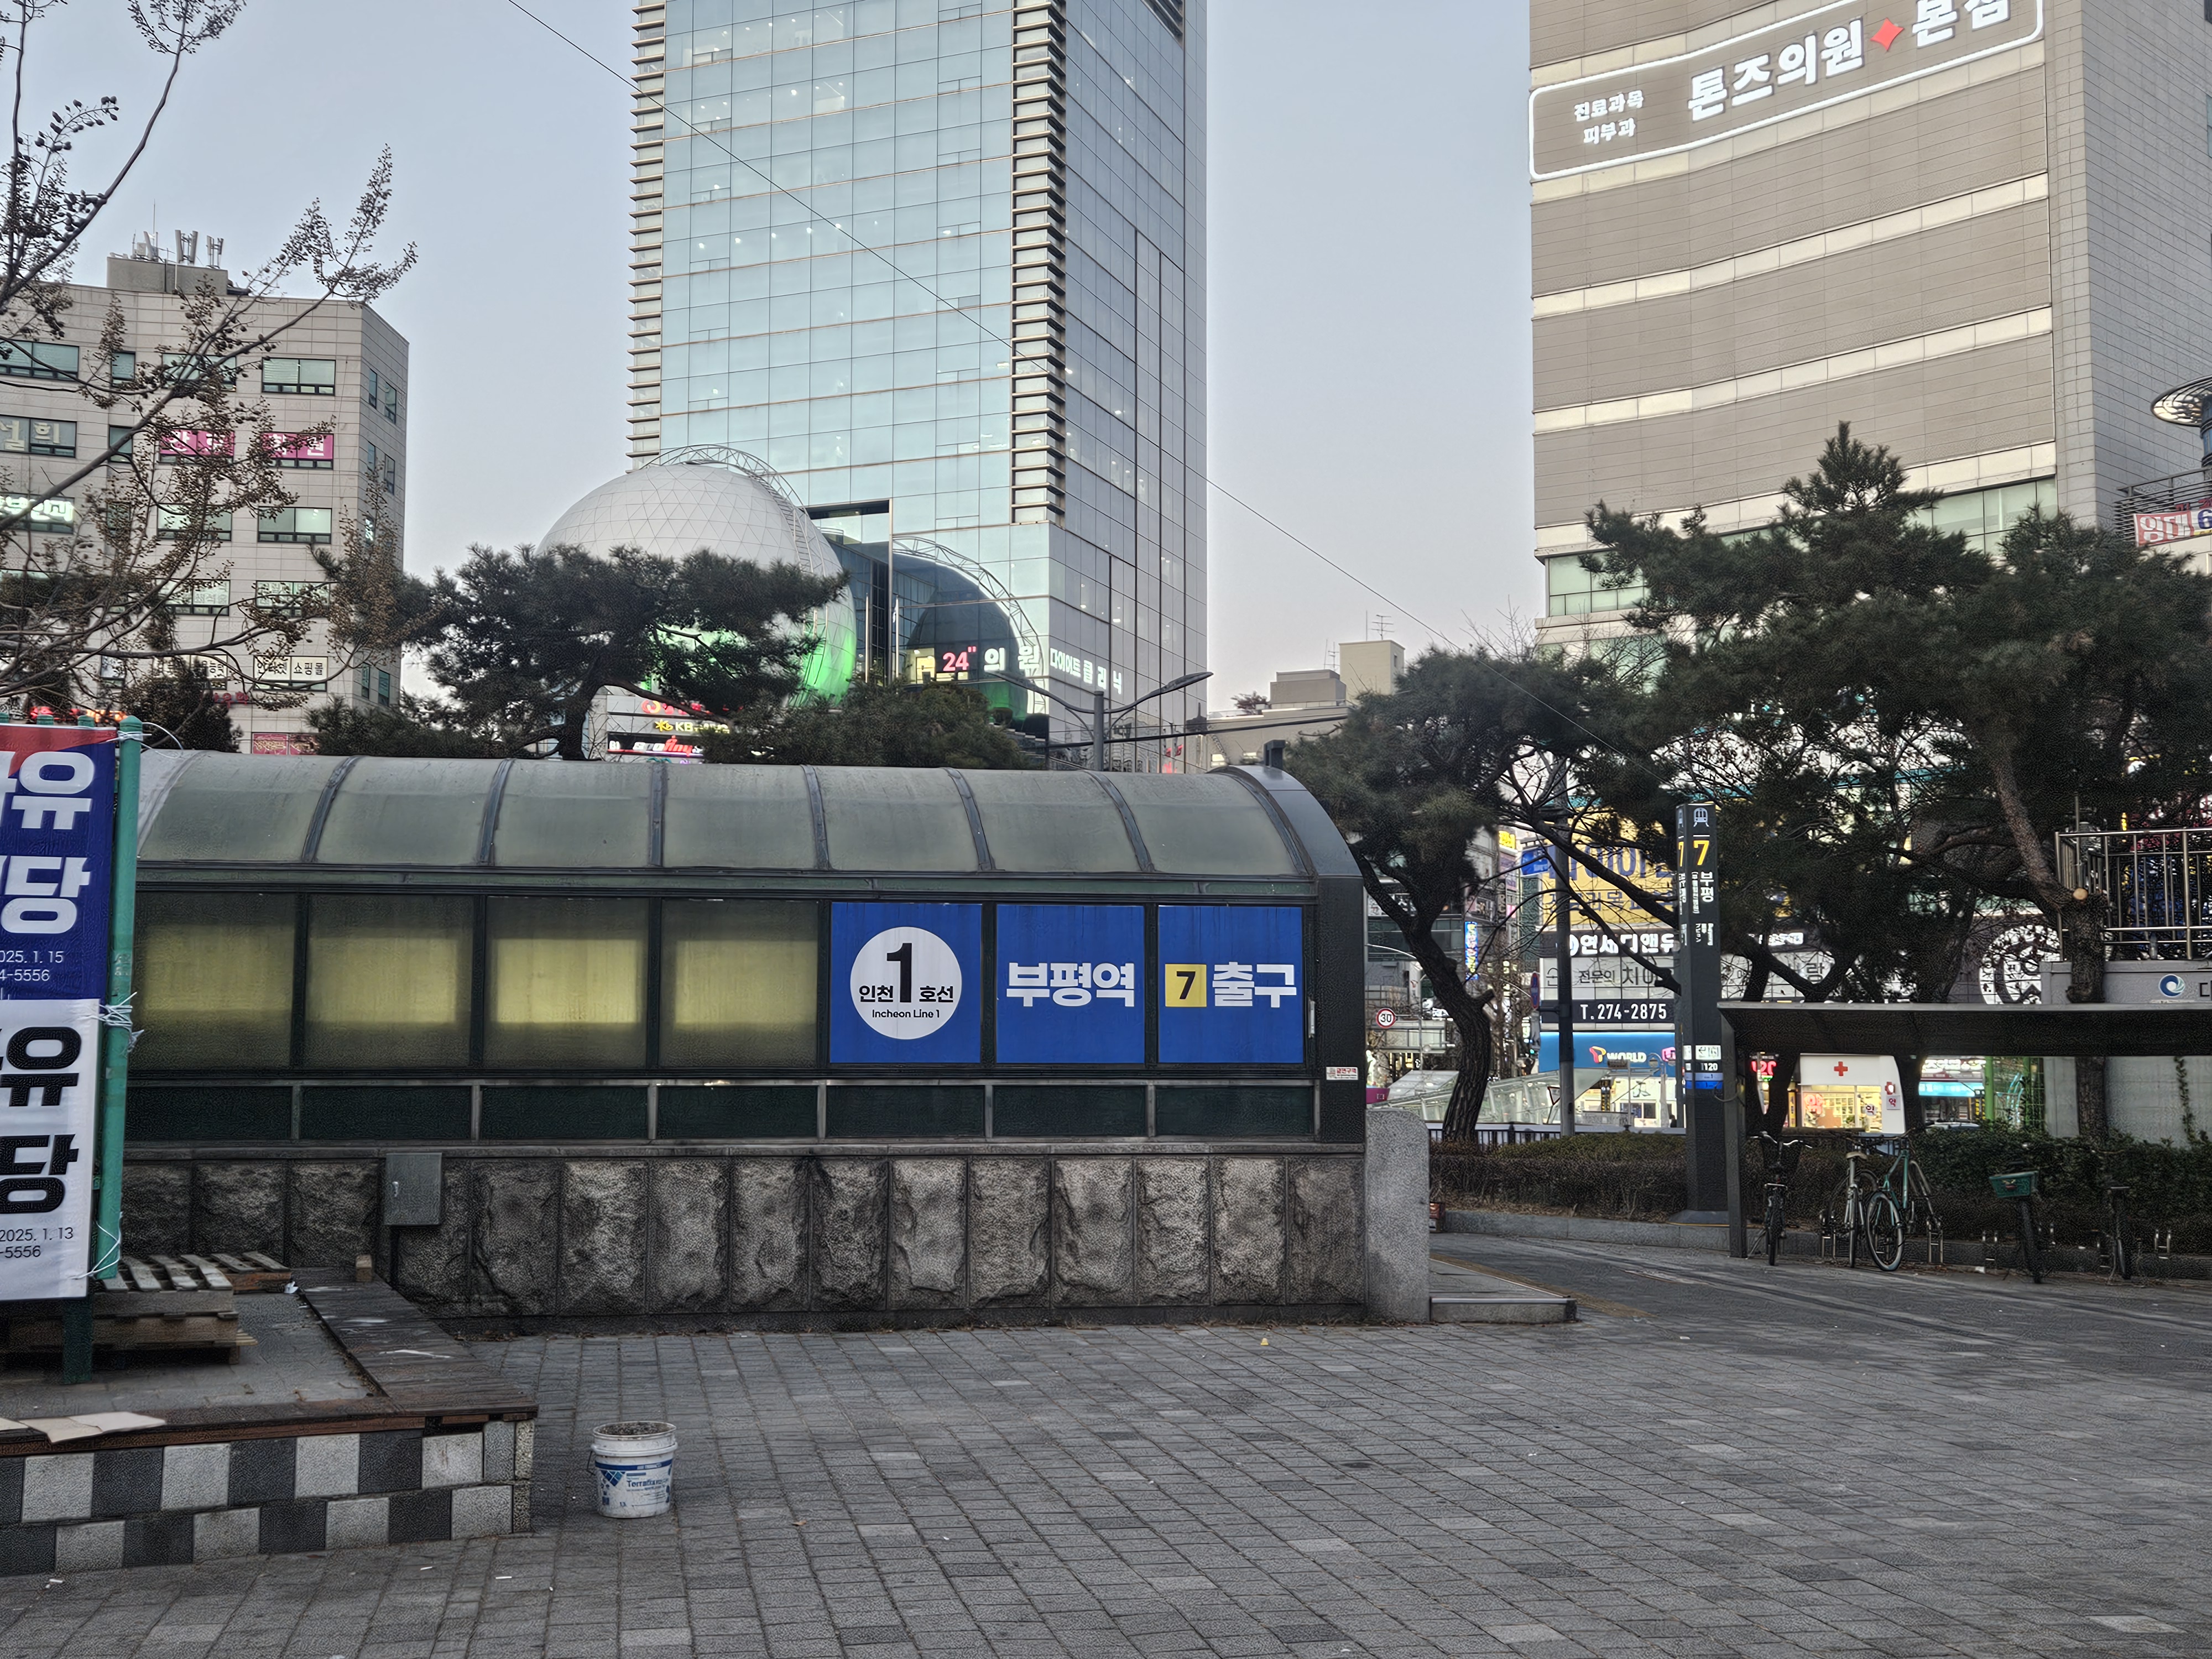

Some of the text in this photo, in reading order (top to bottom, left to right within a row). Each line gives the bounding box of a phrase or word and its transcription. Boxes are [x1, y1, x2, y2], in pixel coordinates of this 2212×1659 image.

[1687, 19, 1865, 121] 톤즈의원
[1574, 90, 1644, 122] 진료과목
[1583, 117, 1636, 144] 피부과
[2140, 514, 2191, 542] 임대
[1693, 839, 1710, 866] 7
[1699, 871, 1714, 902] 부평
[48, 951, 65, 963] 15
[859, 942, 953, 1003] 인천 1 호선
[1006, 962, 1135, 1007] 부평역
[1176, 962, 1297, 1008] 7 출구
[872, 1009, 940, 1018] Incheon Line 1
[1380, 1014, 1392, 1022] 30
[58, 1227, 74, 1240] 13
